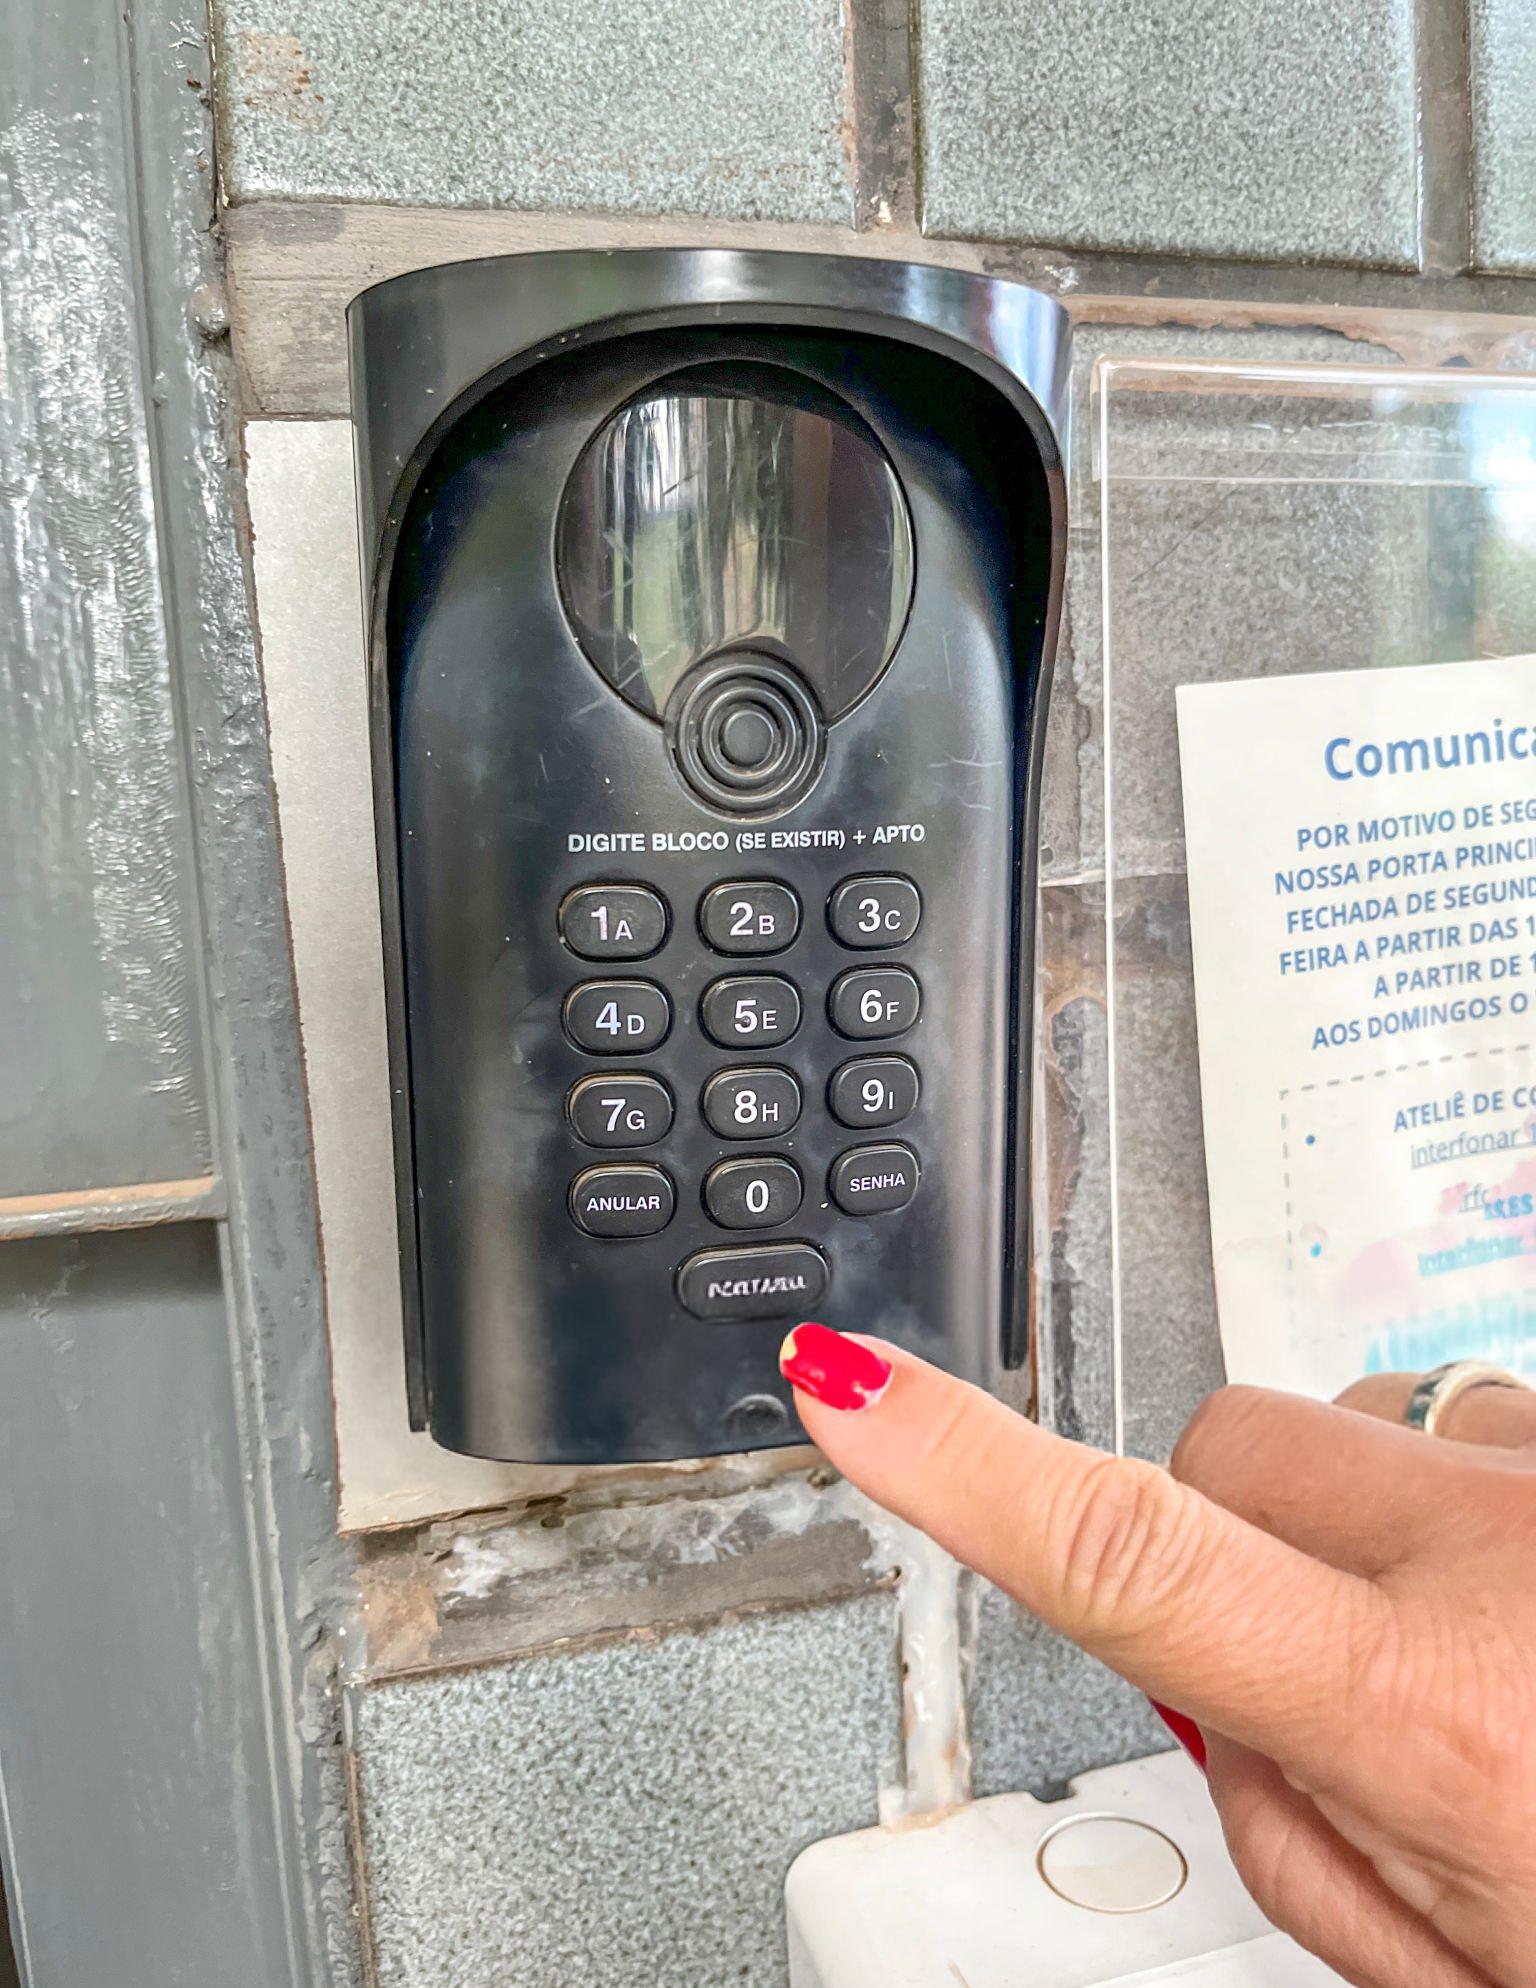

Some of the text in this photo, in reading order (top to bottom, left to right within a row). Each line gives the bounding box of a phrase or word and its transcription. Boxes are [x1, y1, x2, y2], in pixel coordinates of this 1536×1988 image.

[1324, 718, 1536, 780] Comunic
[568, 832, 646, 853] DIGITE
[652, 831, 730, 852] BLOCO
[735, 832, 767, 853] (SE
[771, 829, 846, 850] EXISTIR)
[872, 824, 925, 844] APTO
[1297, 824, 1350, 851] POR
[1357, 809, 1456, 845] MOTIVO
[1463, 805, 1494, 830] DE
[1275, 837, 1536, 896] NOSSA PORTA PRINCI
[1287, 896, 1399, 935] FECHADA
[1406, 890, 1436, 915] DE
[1280, 943, 1348, 976] FEIRA
[1354, 938, 1371, 964] A
[1377, 925, 1461, 959] PARTIR
[1470, 917, 1518, 945] DAS
[1374, 975, 1389, 999] A
[1396, 960, 1482, 995] PARTIR
[1490, 955, 1521, 980] DE
[1312, 992, 1528, 1051] AOS DOMINGOS O
[1394, 1090, 1465, 1133] ATELIÊ
[1473, 1089, 1504, 1115] DE
[1411, 1128, 1520, 1169] interfonar
[586, 1195, 661, 1212] ANULAR
[745, 1179, 770, 1214] 0
[849, 1172, 906, 1193] SENHA
